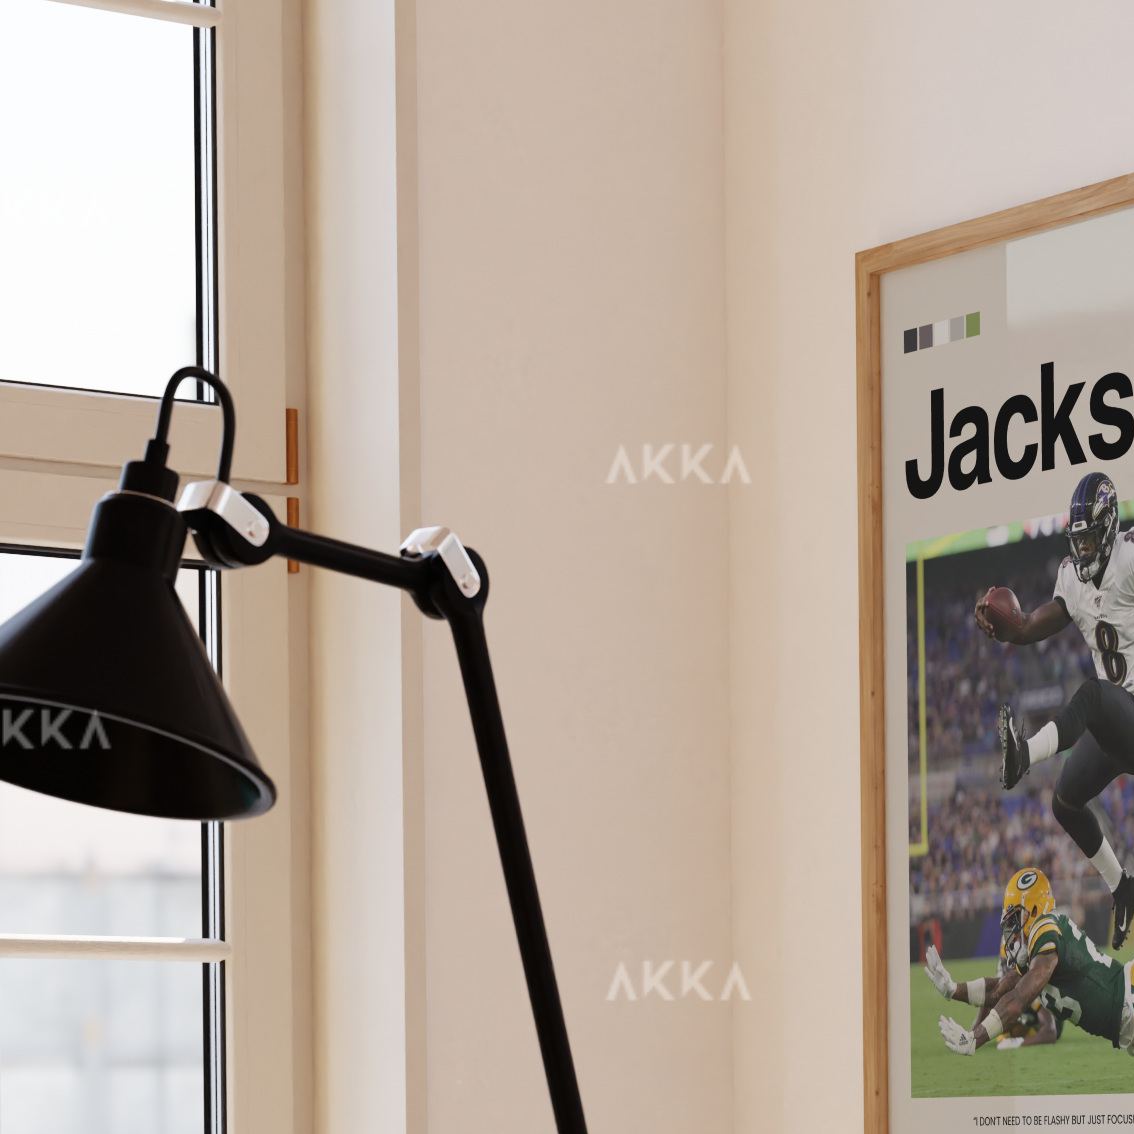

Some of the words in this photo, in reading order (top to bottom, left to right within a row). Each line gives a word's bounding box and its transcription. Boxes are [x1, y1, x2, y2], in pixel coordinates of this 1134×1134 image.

[1095, 620, 1127, 685] 8
[1003, 1116, 1021, 1126] NEED
[1022, 1116, 1032, 1126] TO
[1034, 1116, 1042, 1126] BE
[1044, 1115, 1070, 1126] FLASHY
[1072, 1115, 1085, 1125] BUT
[1088, 1115, 1105, 1125] JUST
